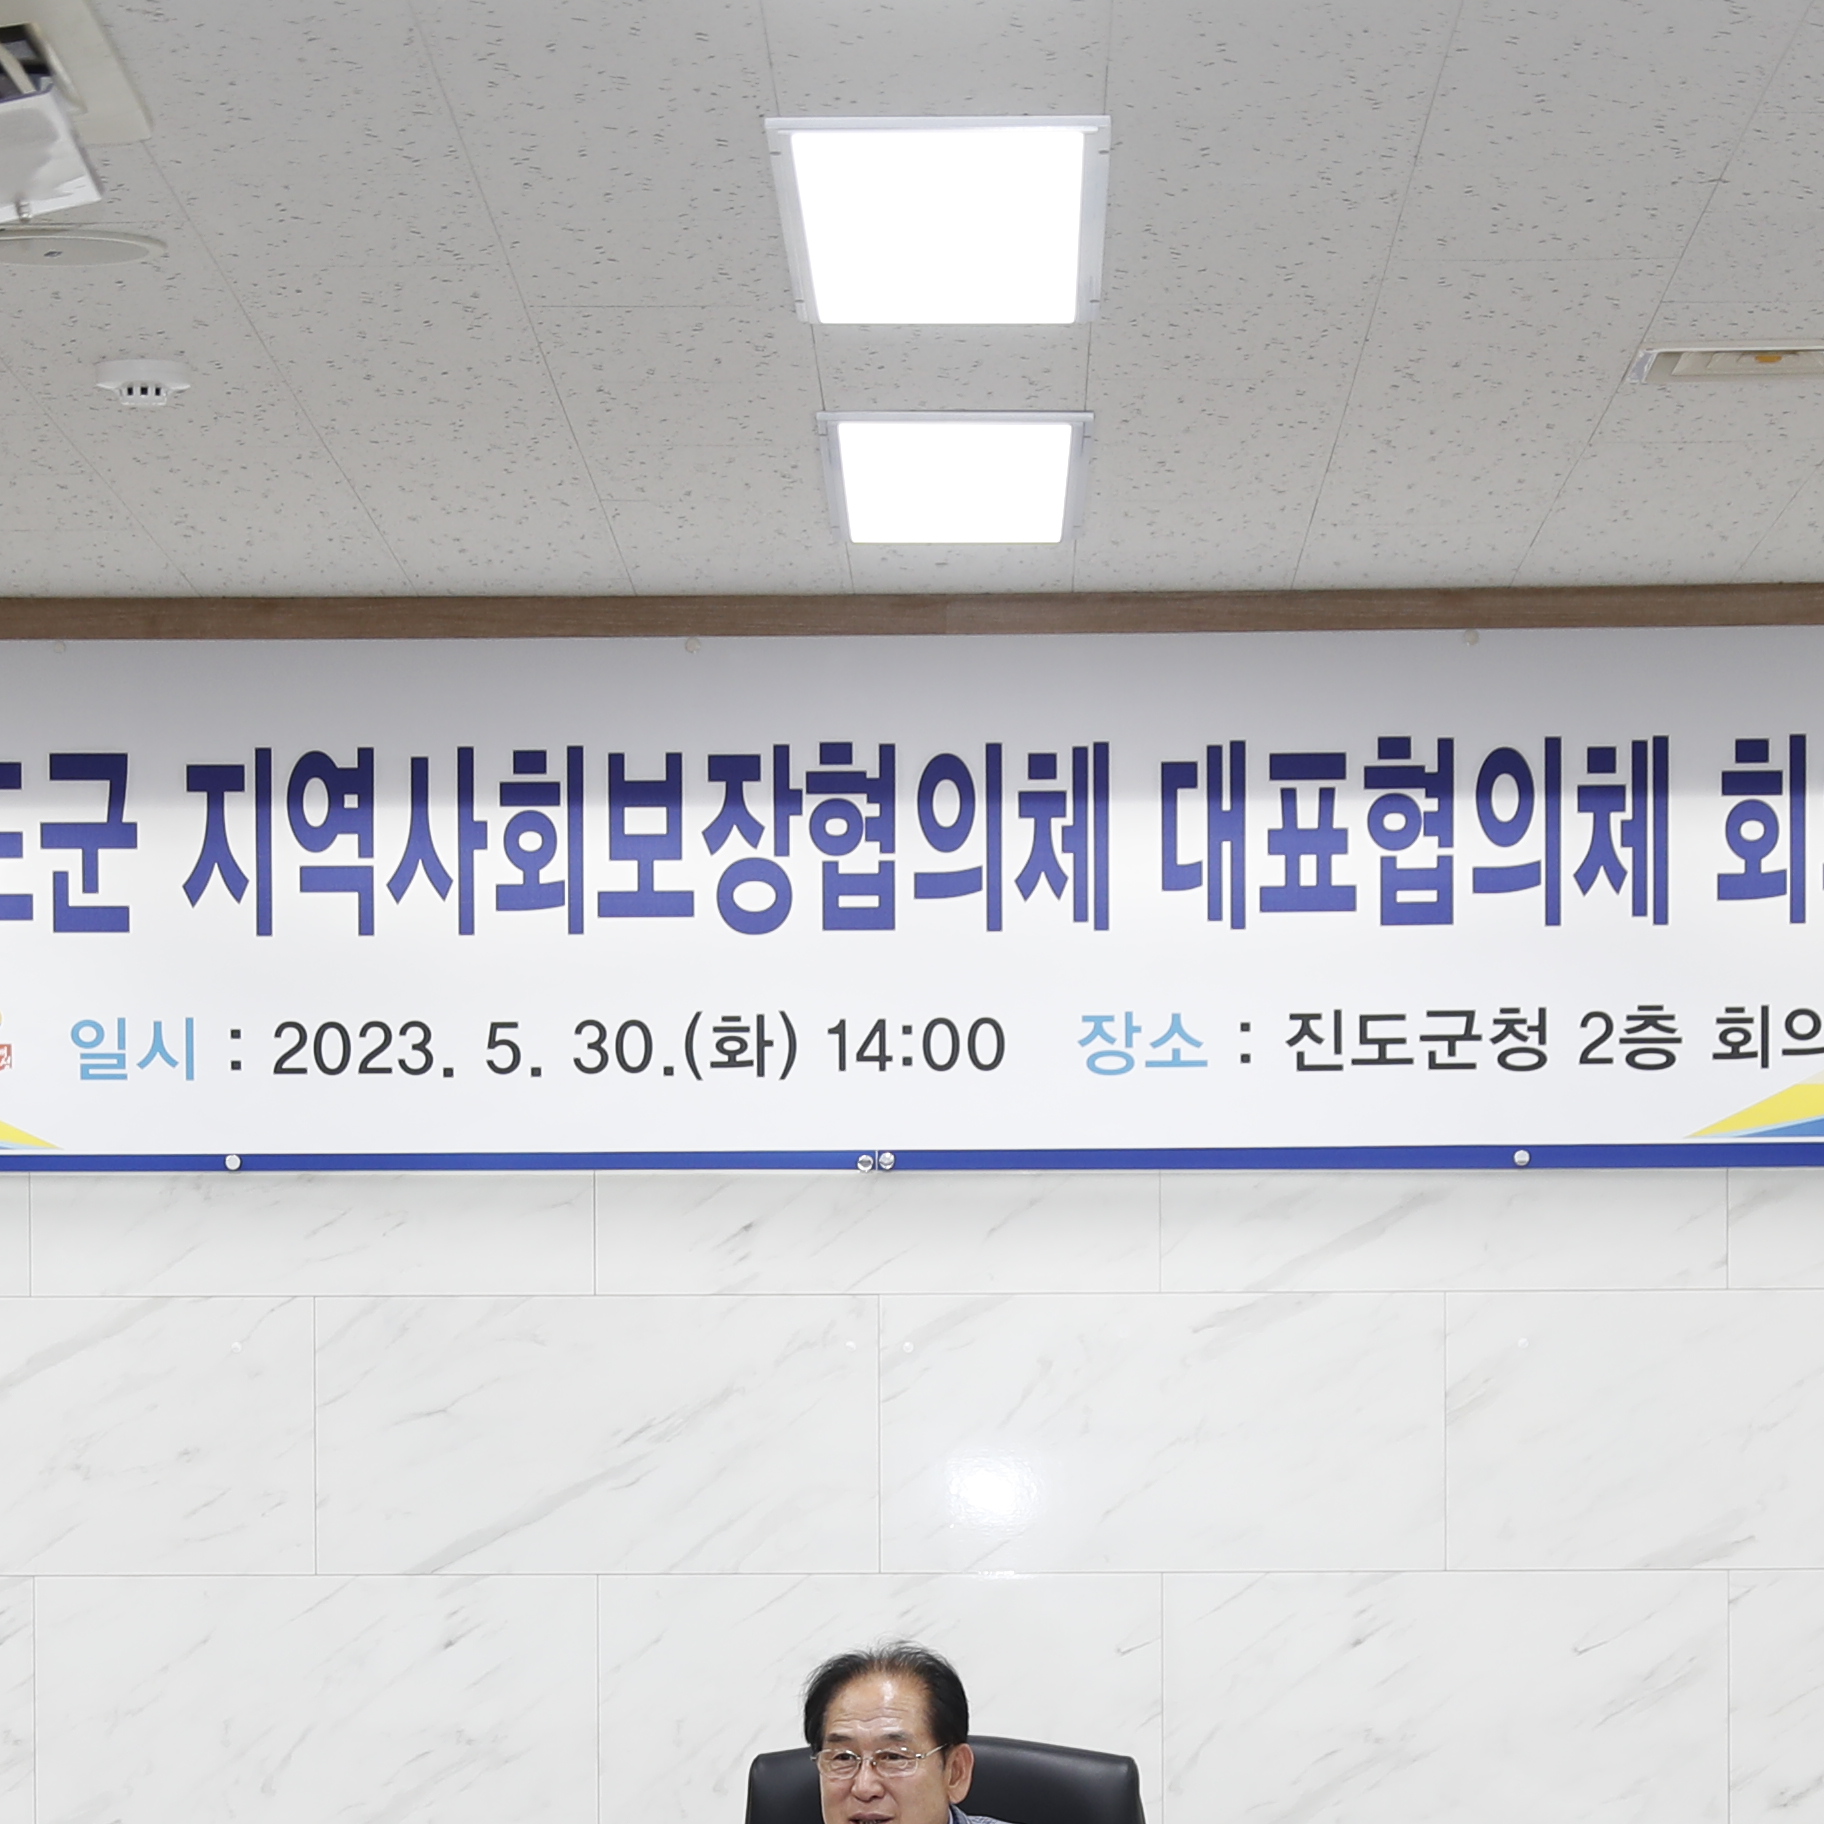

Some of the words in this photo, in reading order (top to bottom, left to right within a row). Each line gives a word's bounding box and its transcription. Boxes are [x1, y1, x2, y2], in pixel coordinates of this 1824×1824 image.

[181, 739, 1110, 938] 지역사회보장협의체
[1160, 733, 1670, 931] 대표협의체
[70, 1016, 197, 1081] 일시
[272, 1019, 455, 1079] 2023.
[485, 1020, 542, 1078] 5.
[827, 1015, 1007, 1074] 14:00
[1077, 1010, 1209, 1076] 장소
[1285, 1006, 1548, 1073] 진도군청
[1578, 1004, 1683, 1072] 2층
